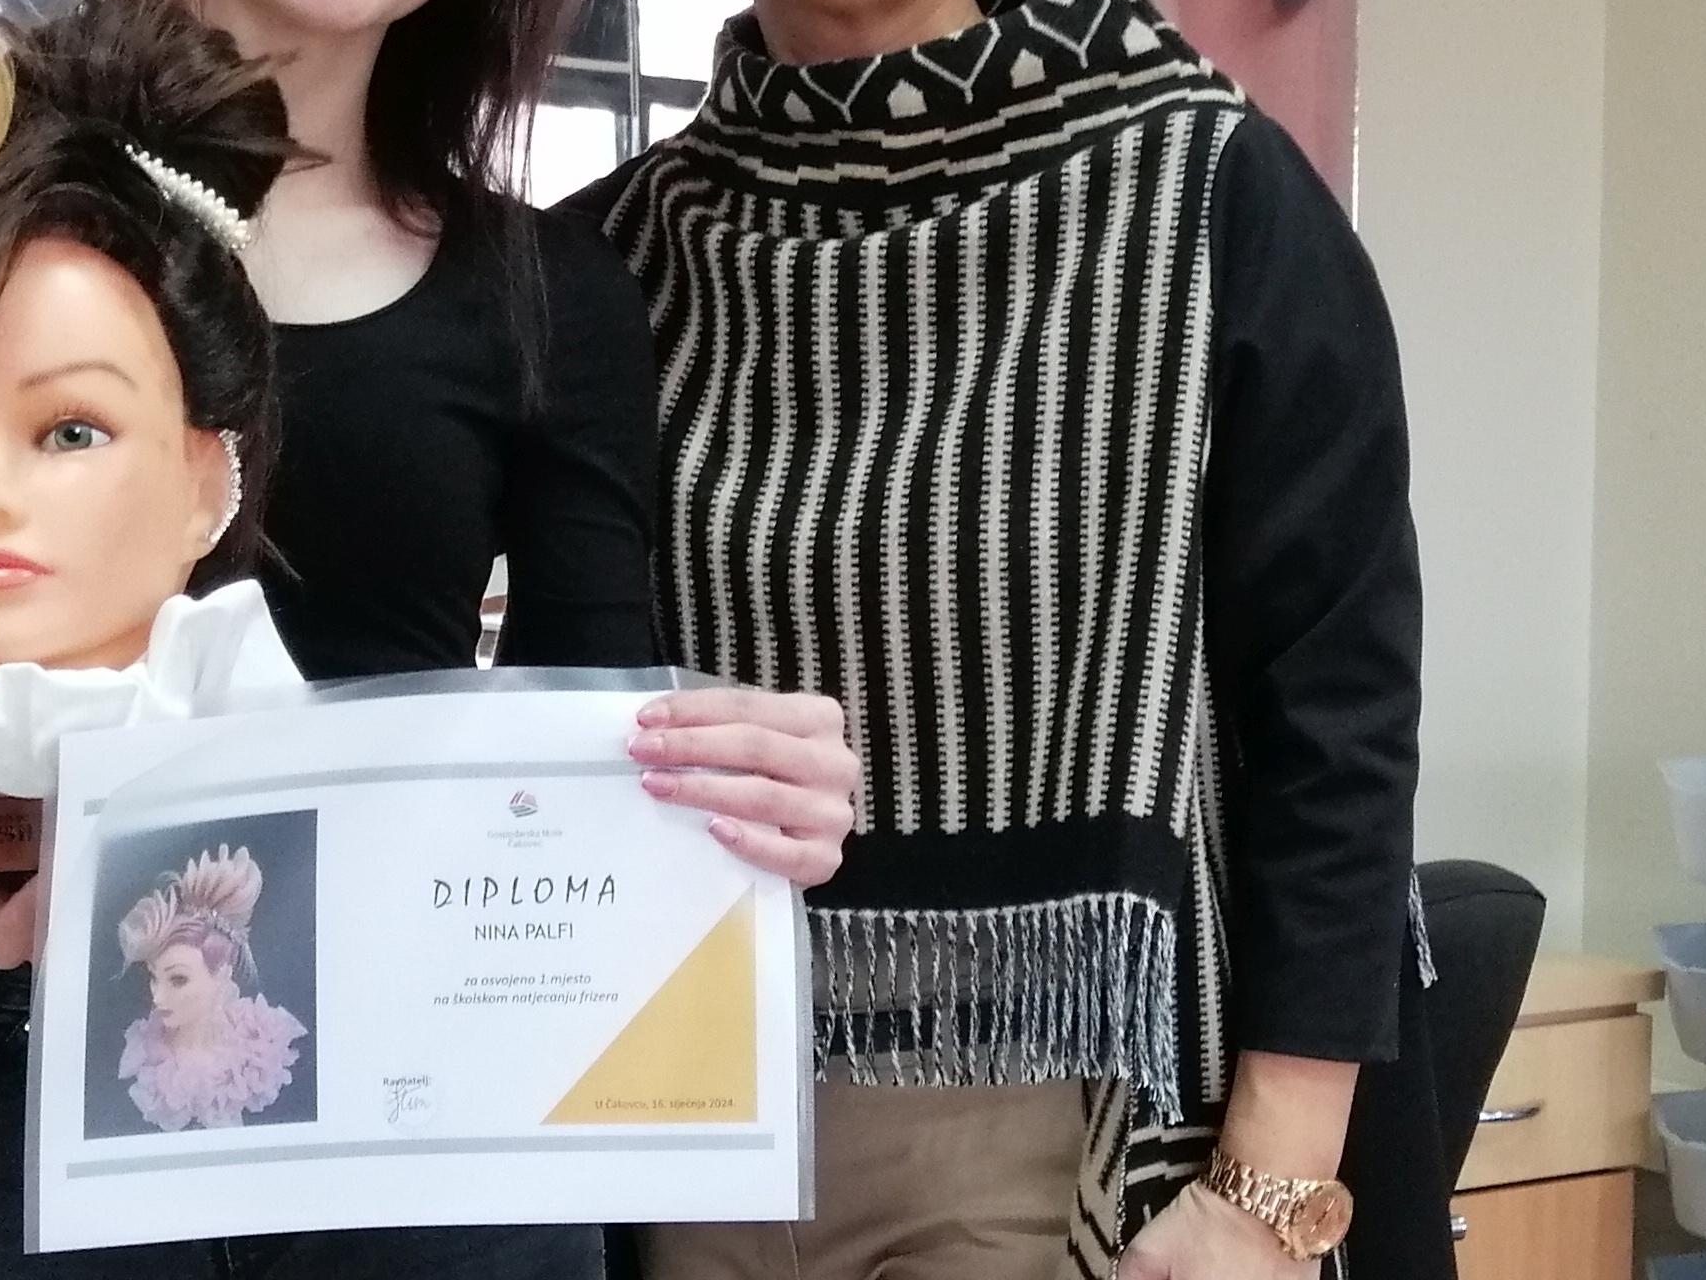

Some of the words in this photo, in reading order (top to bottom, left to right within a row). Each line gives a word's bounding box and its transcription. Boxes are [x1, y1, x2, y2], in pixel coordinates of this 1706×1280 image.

[433, 873, 616, 909] DIPLOMA
[474, 923, 520, 941] NINA
[525, 922, 574, 939] PALFI
[464, 976, 478, 986] za
[481, 974, 536, 988] osvojeno
[433, 994, 449, 1006] na
[453, 991, 508, 1005] školskom
[511, 991, 576, 1005] natjecanju
[579, 990, 619, 1005] frizera
